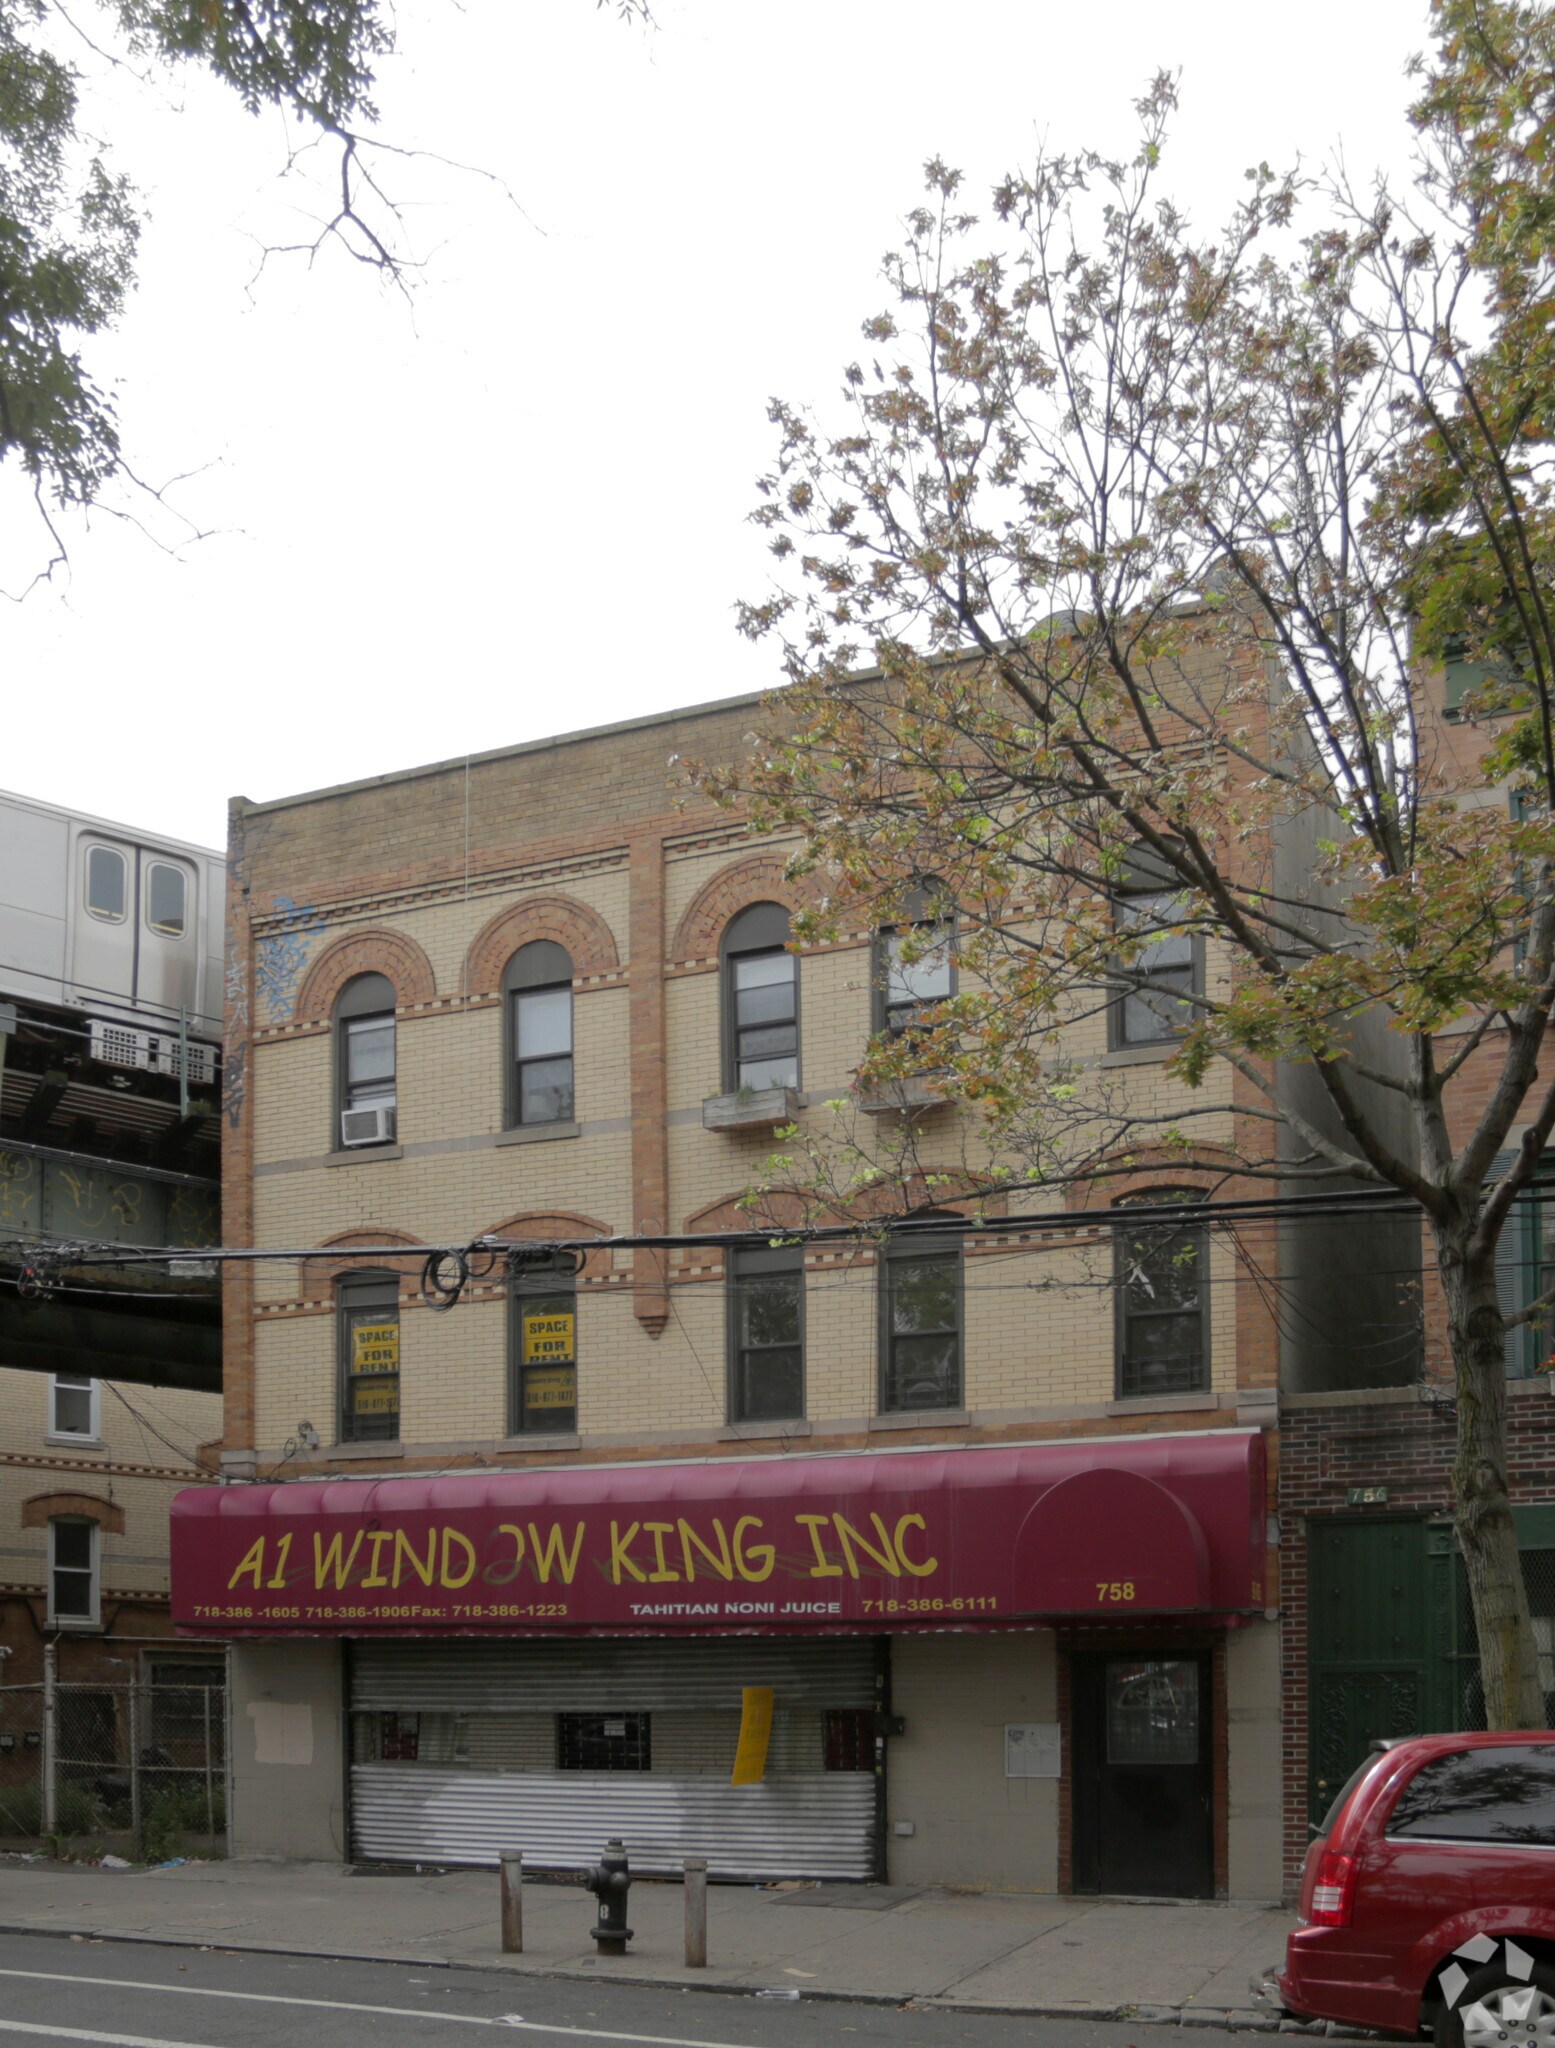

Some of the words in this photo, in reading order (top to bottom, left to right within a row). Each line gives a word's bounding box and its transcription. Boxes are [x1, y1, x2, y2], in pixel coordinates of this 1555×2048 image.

[529, 1320, 568, 1334] SPACE
[358, 1330, 395, 1344] SPACE
[533, 1341, 566, 1353] FOR
[363, 1350, 394, 1361] FOR
[1352, 1486, 1386, 1503] 756
[227, 1532, 293, 1589] A1
[610, 1515, 776, 1585] KING
[795, 1512, 938, 1579] INC
[1096, 1582, 1135, 1601] 758
[452, 1604, 568, 1617] 718-386-1223
[630, 1603, 718, 1616] TAHITIAN
[780, 1602, 841, 1614] JUICE
[862, 1597, 998, 1613] 718-386-6111
